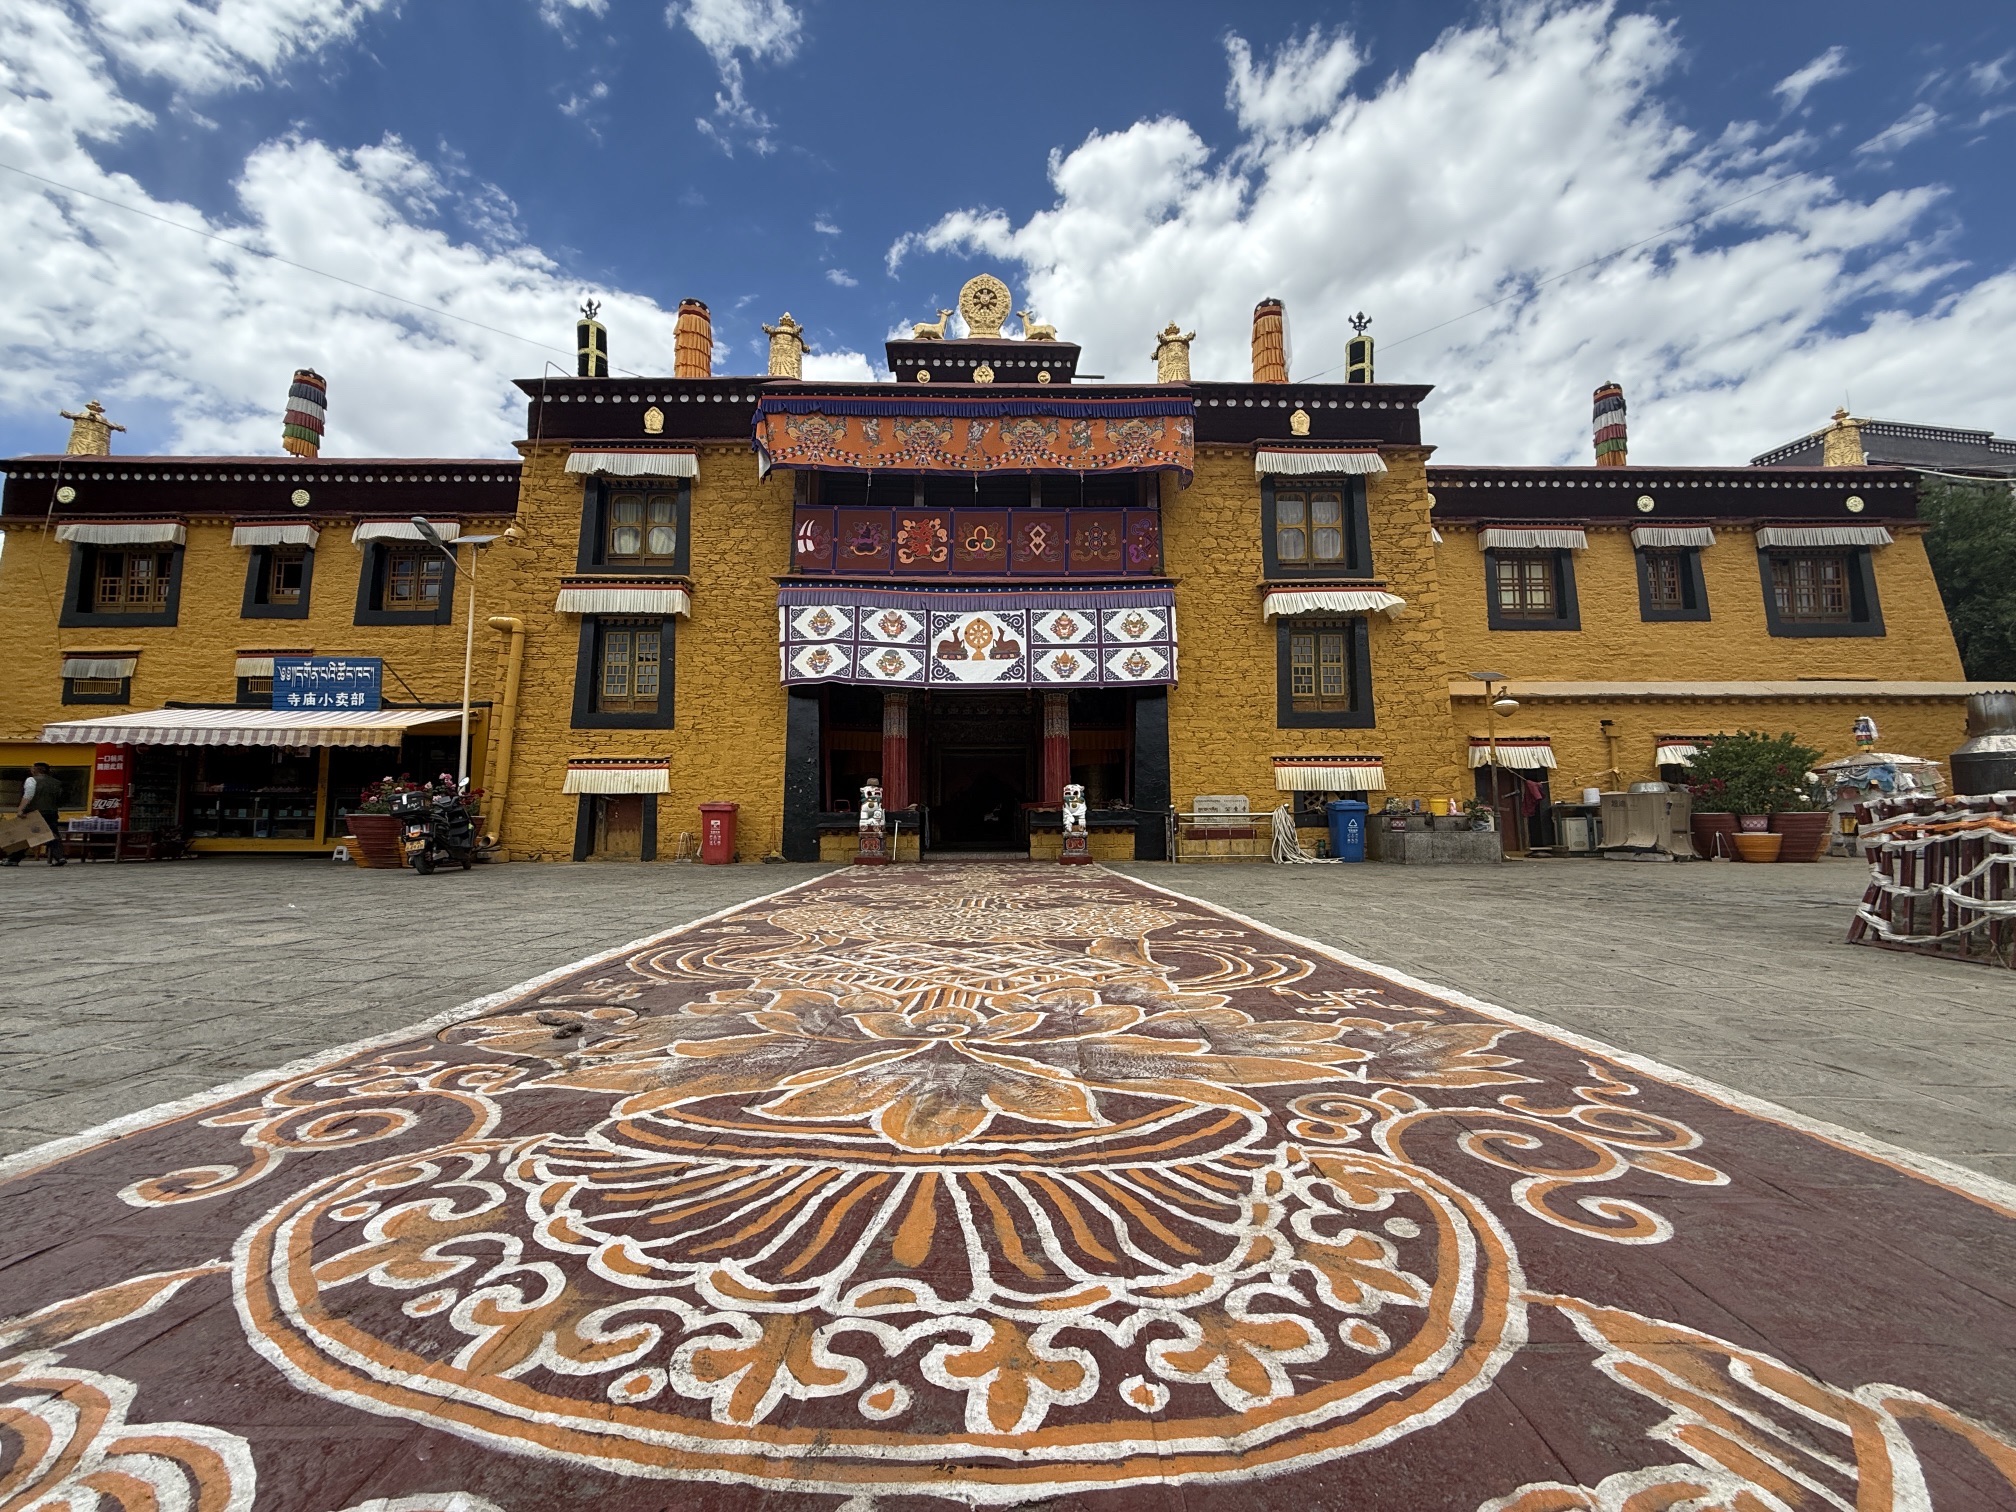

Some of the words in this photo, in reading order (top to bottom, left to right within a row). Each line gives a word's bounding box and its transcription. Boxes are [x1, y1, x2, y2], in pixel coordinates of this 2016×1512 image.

[286, 692, 365, 707] 寺庙小卖部
[92, 798, 122, 810] 可口可乐
